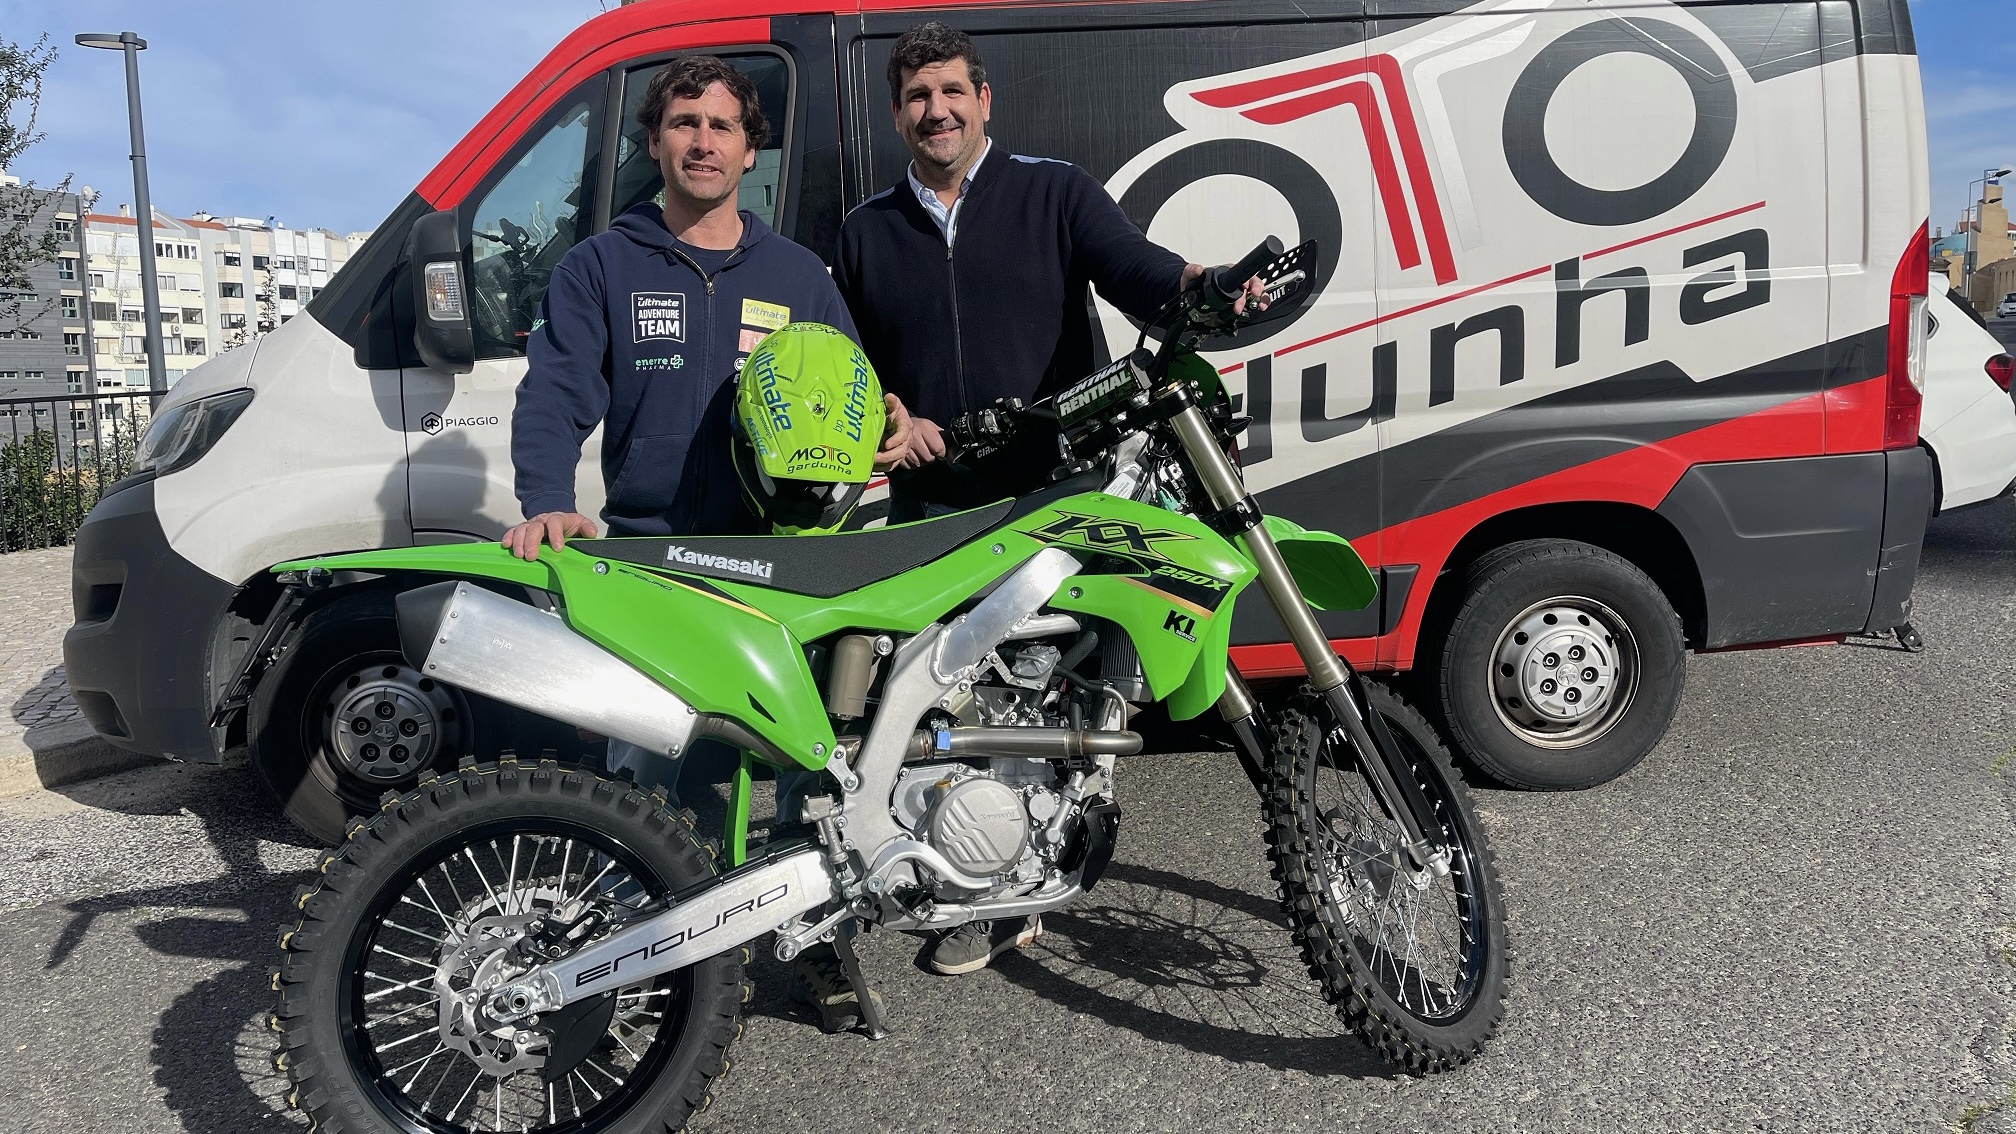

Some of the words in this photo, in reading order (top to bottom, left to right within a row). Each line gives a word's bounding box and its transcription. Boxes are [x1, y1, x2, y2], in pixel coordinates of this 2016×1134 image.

[637, 298, 680, 307] ultimate
[638, 308, 680, 320] ADVENTURE
[745, 305, 787, 321] ultimate
[638, 320, 680, 337] TEAM
[1232, 228, 1770, 467] dunha
[635, 357, 669, 367] enerre
[843, 347, 868, 443] ultimate
[1059, 369, 1132, 417] RENTHAL
[445, 416, 499, 427] PIAGGIO
[833, 419, 845, 433] bp
[788, 444, 852, 466] MOTO
[786, 460, 852, 475] gardunha
[1029, 508, 1202, 563] KX
[666, 545, 773, 579] Kawasaki
[1152, 565, 1231, 592] 250X
